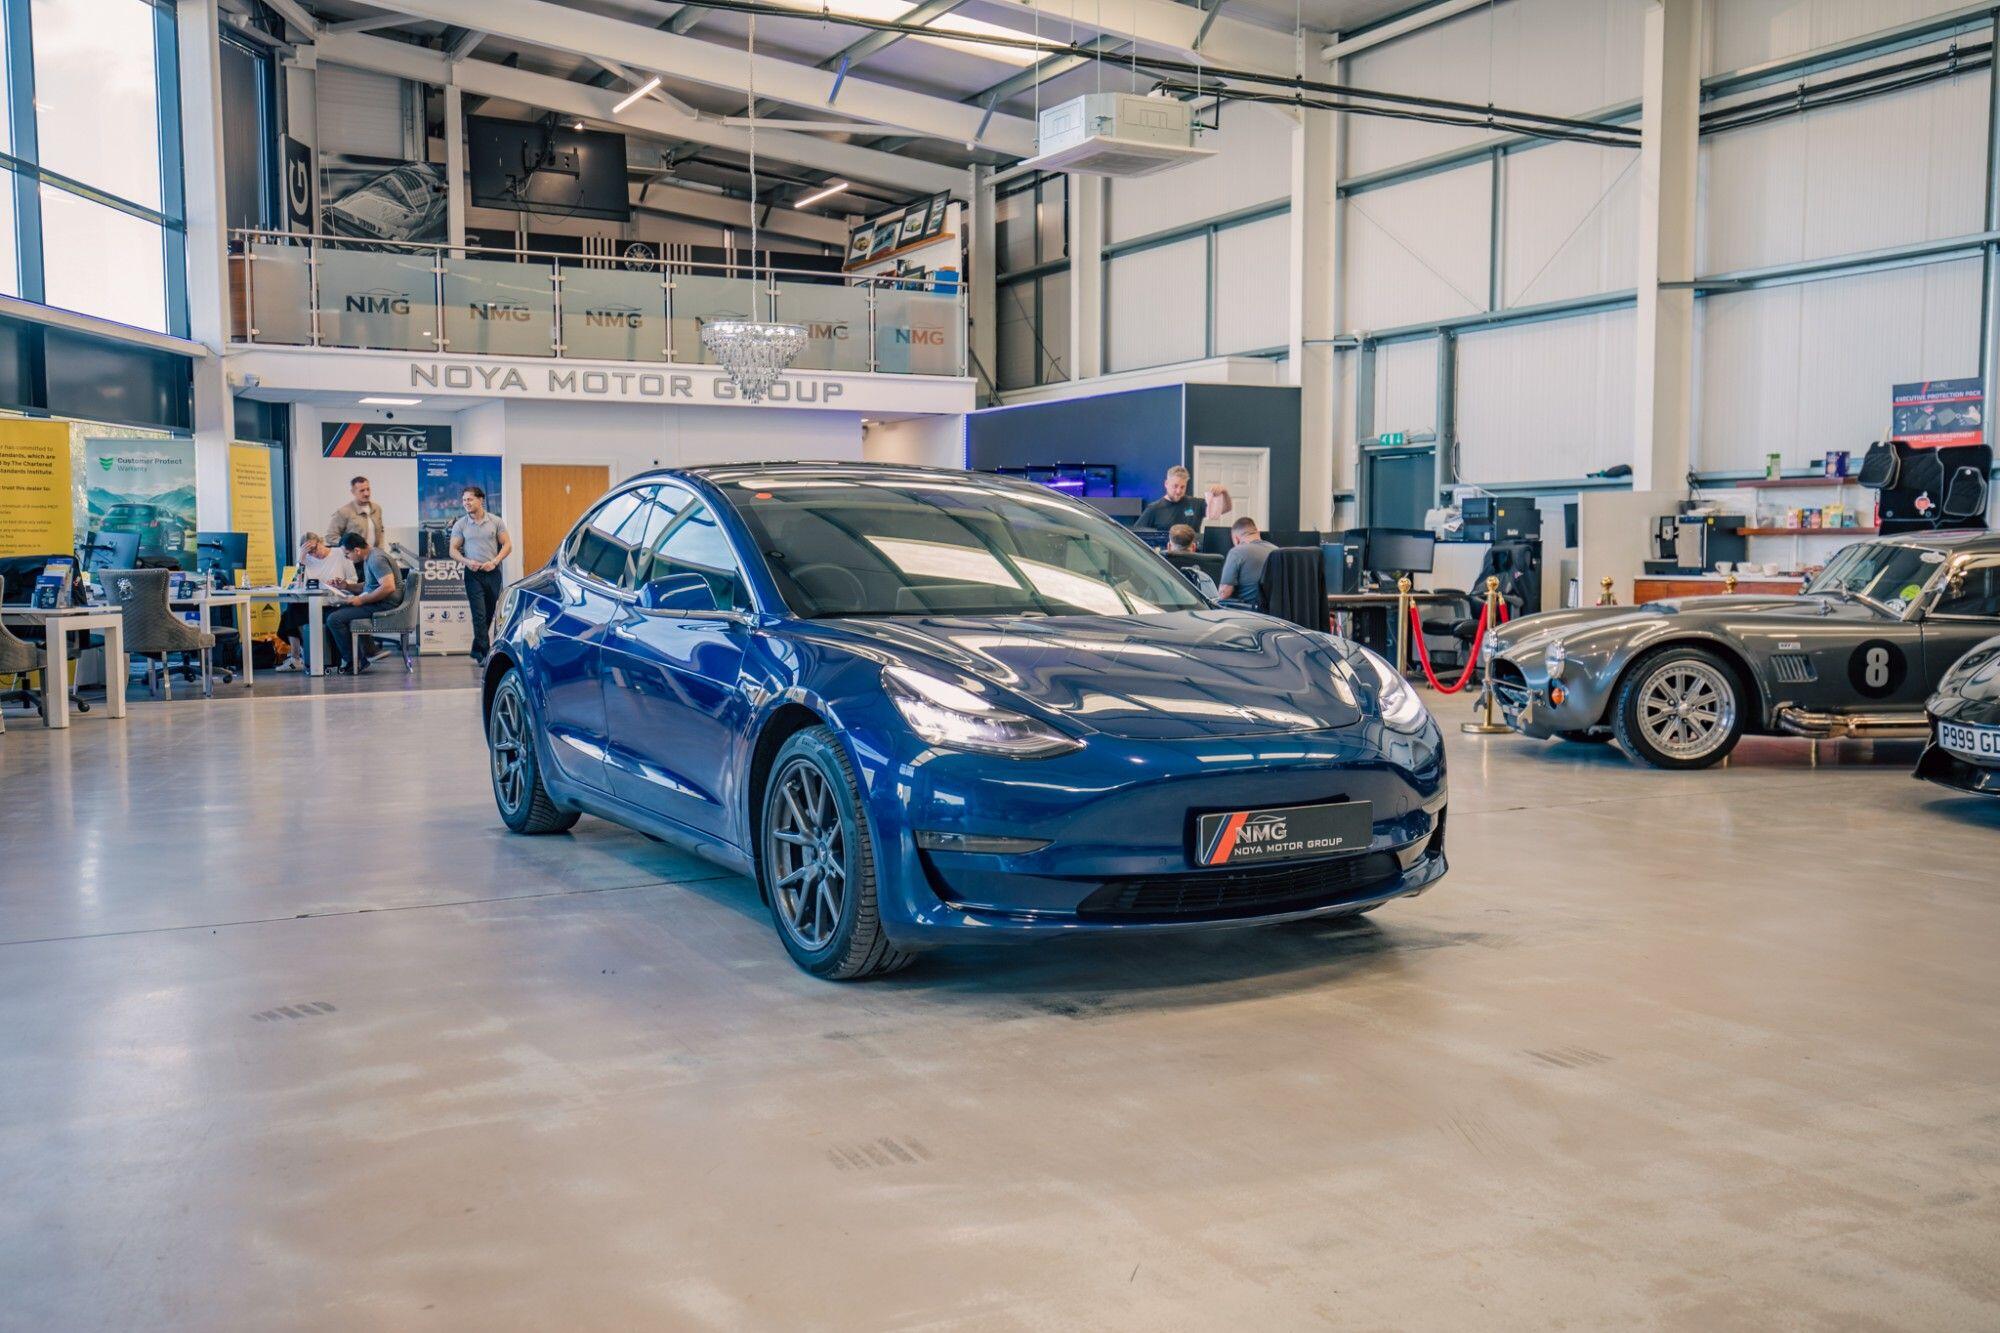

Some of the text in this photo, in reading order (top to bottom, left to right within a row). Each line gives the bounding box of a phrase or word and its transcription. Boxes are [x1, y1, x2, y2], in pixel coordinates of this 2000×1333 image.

[346, 294, 410, 315] NMG
[469, 302, 531, 322] NMG
[585, 310, 643, 329] NMG
[896, 328, 945, 345] NMG
[411, 363, 844, 403] NOYA MOTOR GOUP
[1895, 394, 1927, 403] EXECUTIVE
[1927, 391, 1965, 400] PROTECTION
[366, 434, 428, 451] NMG
[117, 457, 153, 465] Customer
[1865, 647, 1889, 687] 8
[1942, 725, 1975, 751] P999
[1235, 821, 1288, 845] NMG
[1234, 837, 1343, 857] NOYA MOTOR GROUP
